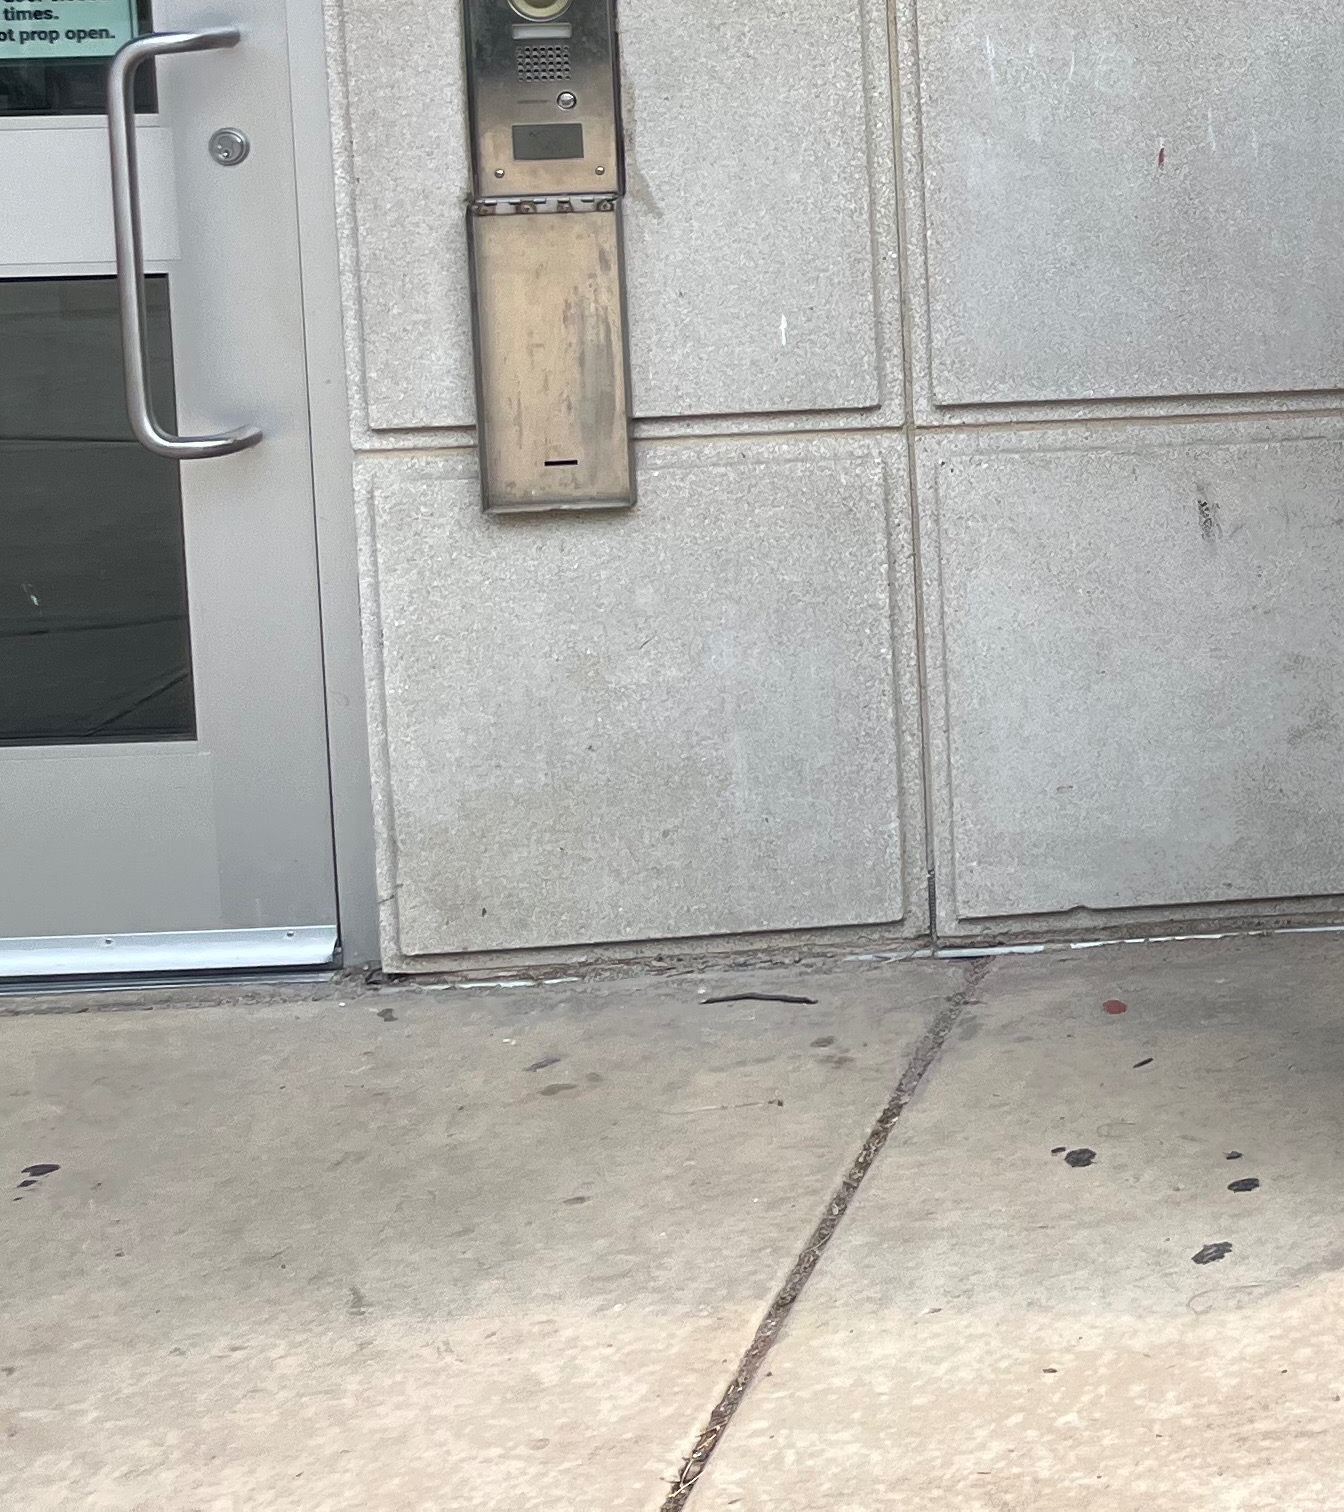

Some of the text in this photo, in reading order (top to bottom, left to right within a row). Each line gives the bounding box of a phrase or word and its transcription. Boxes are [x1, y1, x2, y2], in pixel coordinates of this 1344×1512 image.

[3, 6, 60, 21] times.
[19, 29, 60, 45] prop
[65, 28, 116, 43] open.
